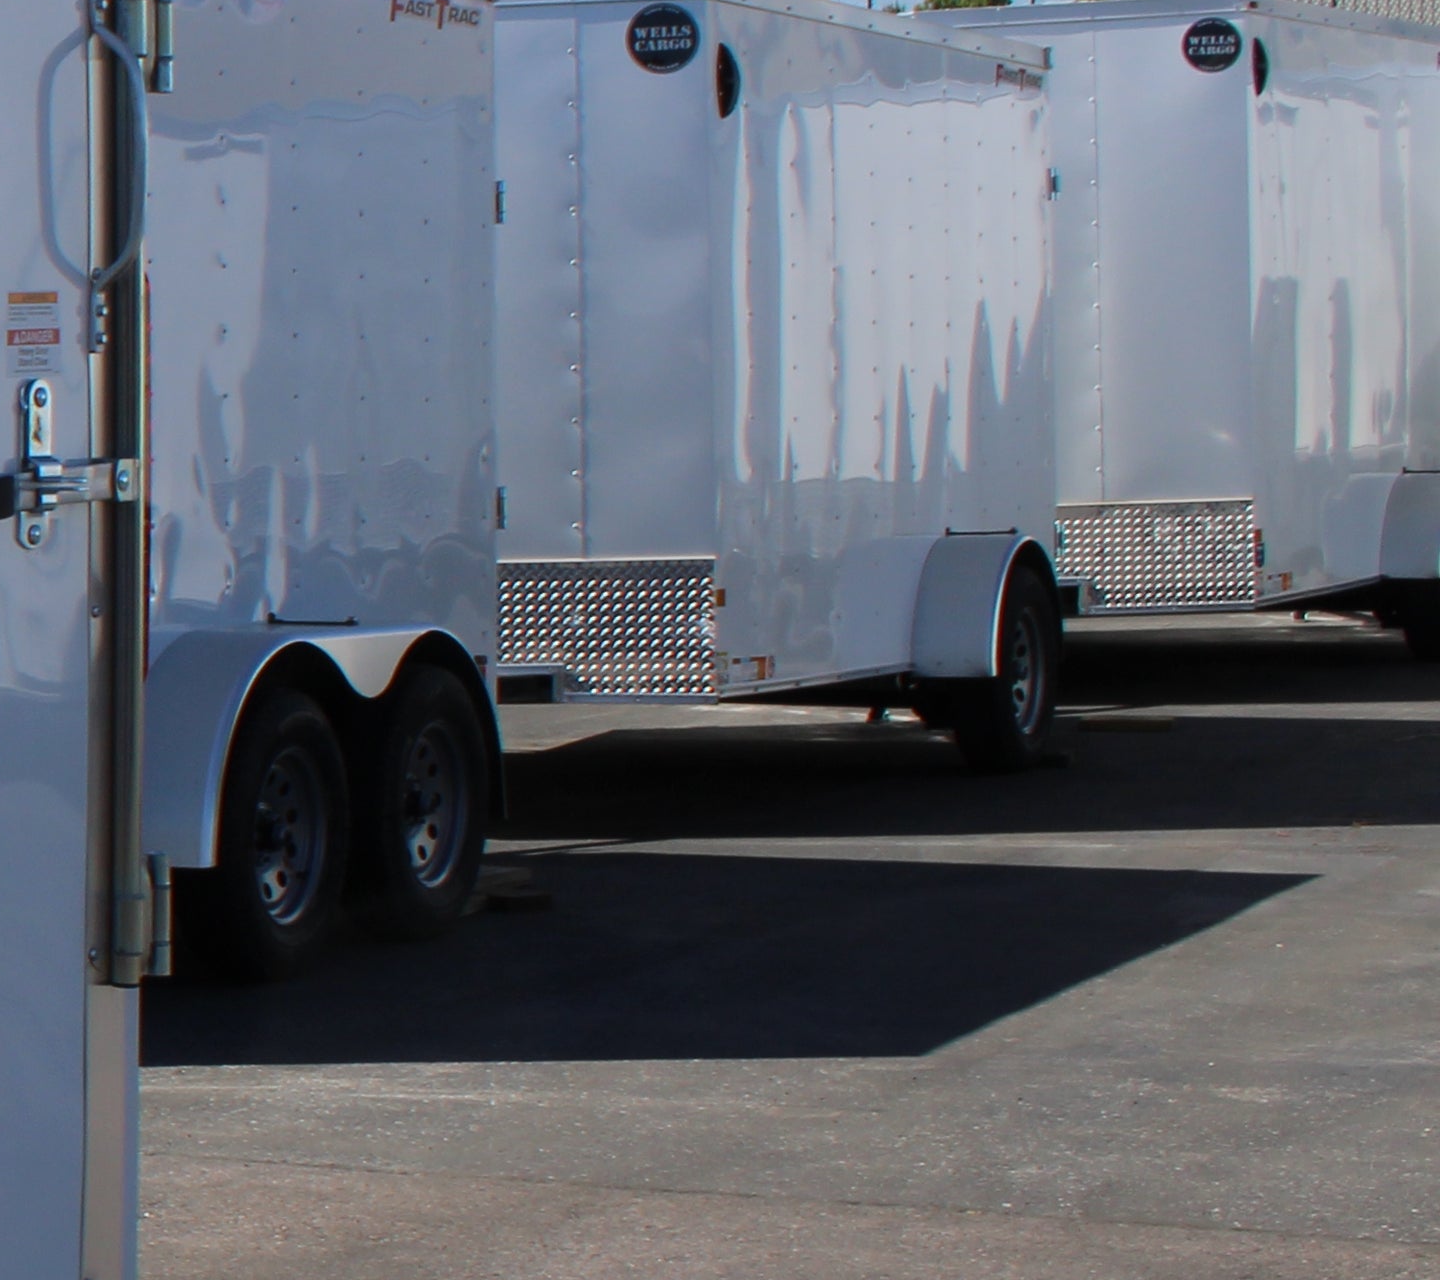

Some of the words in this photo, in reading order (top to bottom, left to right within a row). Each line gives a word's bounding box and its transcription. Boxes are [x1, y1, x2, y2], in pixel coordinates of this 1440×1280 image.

[634, 25, 692, 39] WELLS
[634, 39, 693, 52] CARGO
[1188, 35, 1236, 45] WELLS
[1188, 45, 1236, 55] CARGO
